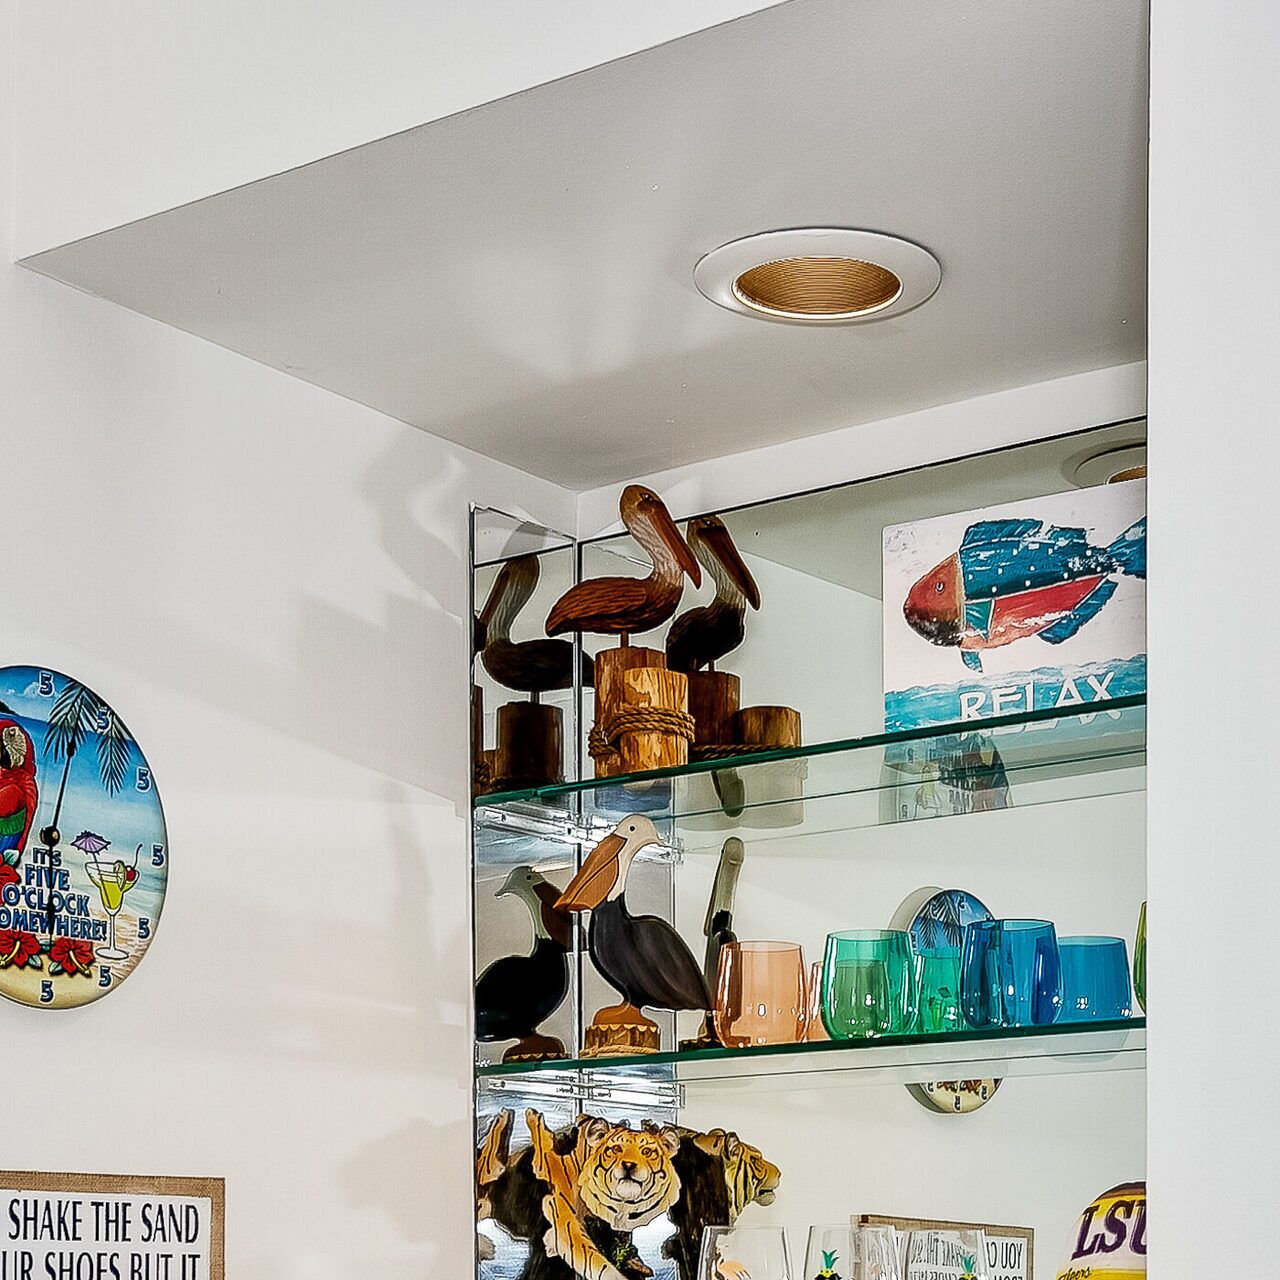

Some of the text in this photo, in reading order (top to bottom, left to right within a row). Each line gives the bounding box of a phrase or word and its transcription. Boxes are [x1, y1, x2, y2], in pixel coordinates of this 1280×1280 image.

[40, 673, 52, 696] 5
[959, 671, 1122, 741] RELAX
[98, 708, 109, 730] 5
[137, 768, 150, 792] 5
[33, 847, 62, 867] IT'S
[152, 845, 165, 866] 5
[25, 865, 71, 891] FIVE
[3, 883, 91, 917] O'CLOCK
[138, 917, 150, 939] 5
[100, 966, 111, 987] 5
[41, 981, 53, 1002] 5
[8, 1198, 83, 1242] SHAKE
[90, 1201, 133, 1243] THE
[140, 1202, 200, 1244] SAND
